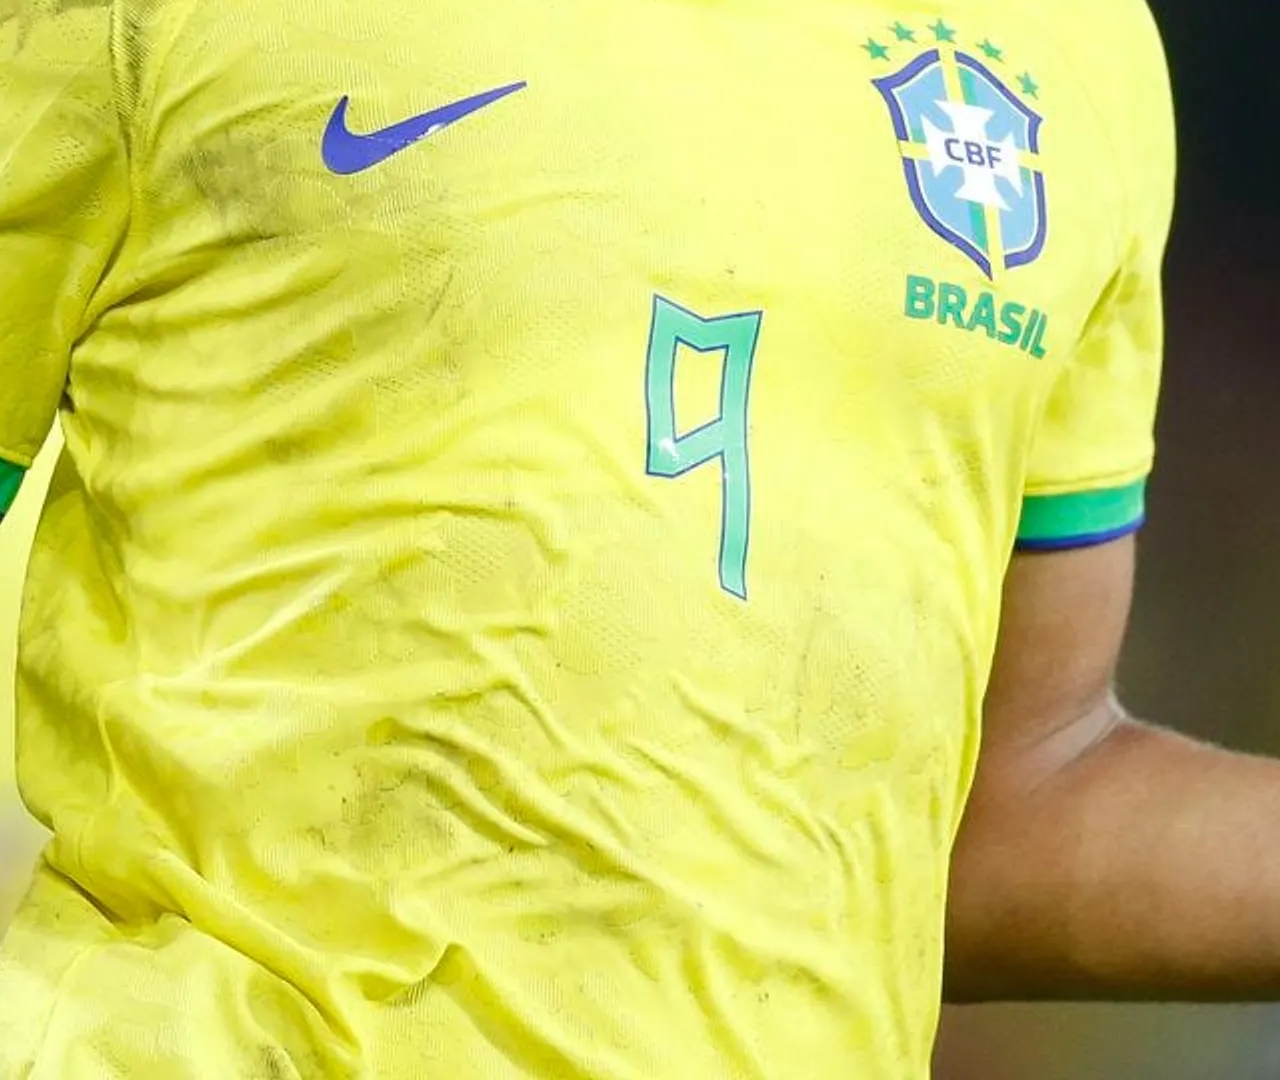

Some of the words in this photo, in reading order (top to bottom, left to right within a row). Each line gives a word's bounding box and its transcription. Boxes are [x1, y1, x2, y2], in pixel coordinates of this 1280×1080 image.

[944, 137, 1002, 169] CBF
[904, 273, 1048, 360] BRASIL
[645, 293, 763, 601] 9
